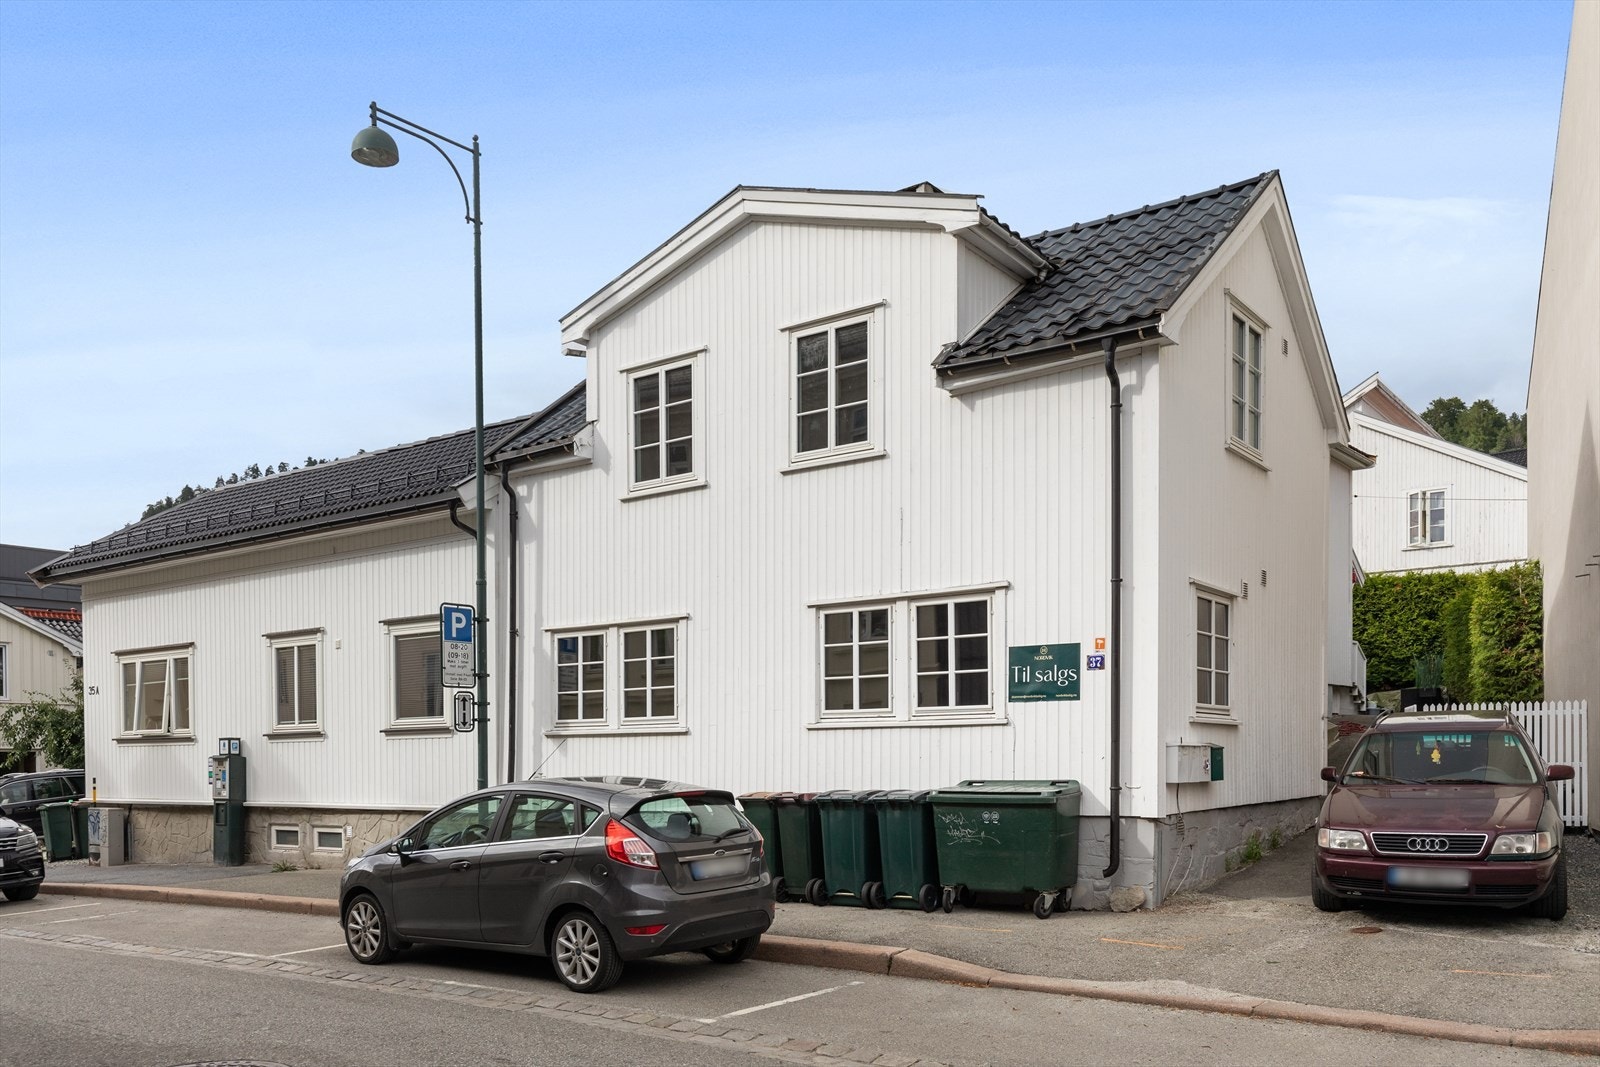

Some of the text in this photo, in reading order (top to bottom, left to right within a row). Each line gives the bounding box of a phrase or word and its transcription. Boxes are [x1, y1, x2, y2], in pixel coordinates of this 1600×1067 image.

[451, 612, 467, 638] P
[450, 643, 468, 651] 08-20
[447, 651, 469, 660] (09-18)
[1090, 657, 1101, 668] 37
[1011, 664, 1078, 687] Til salgs
